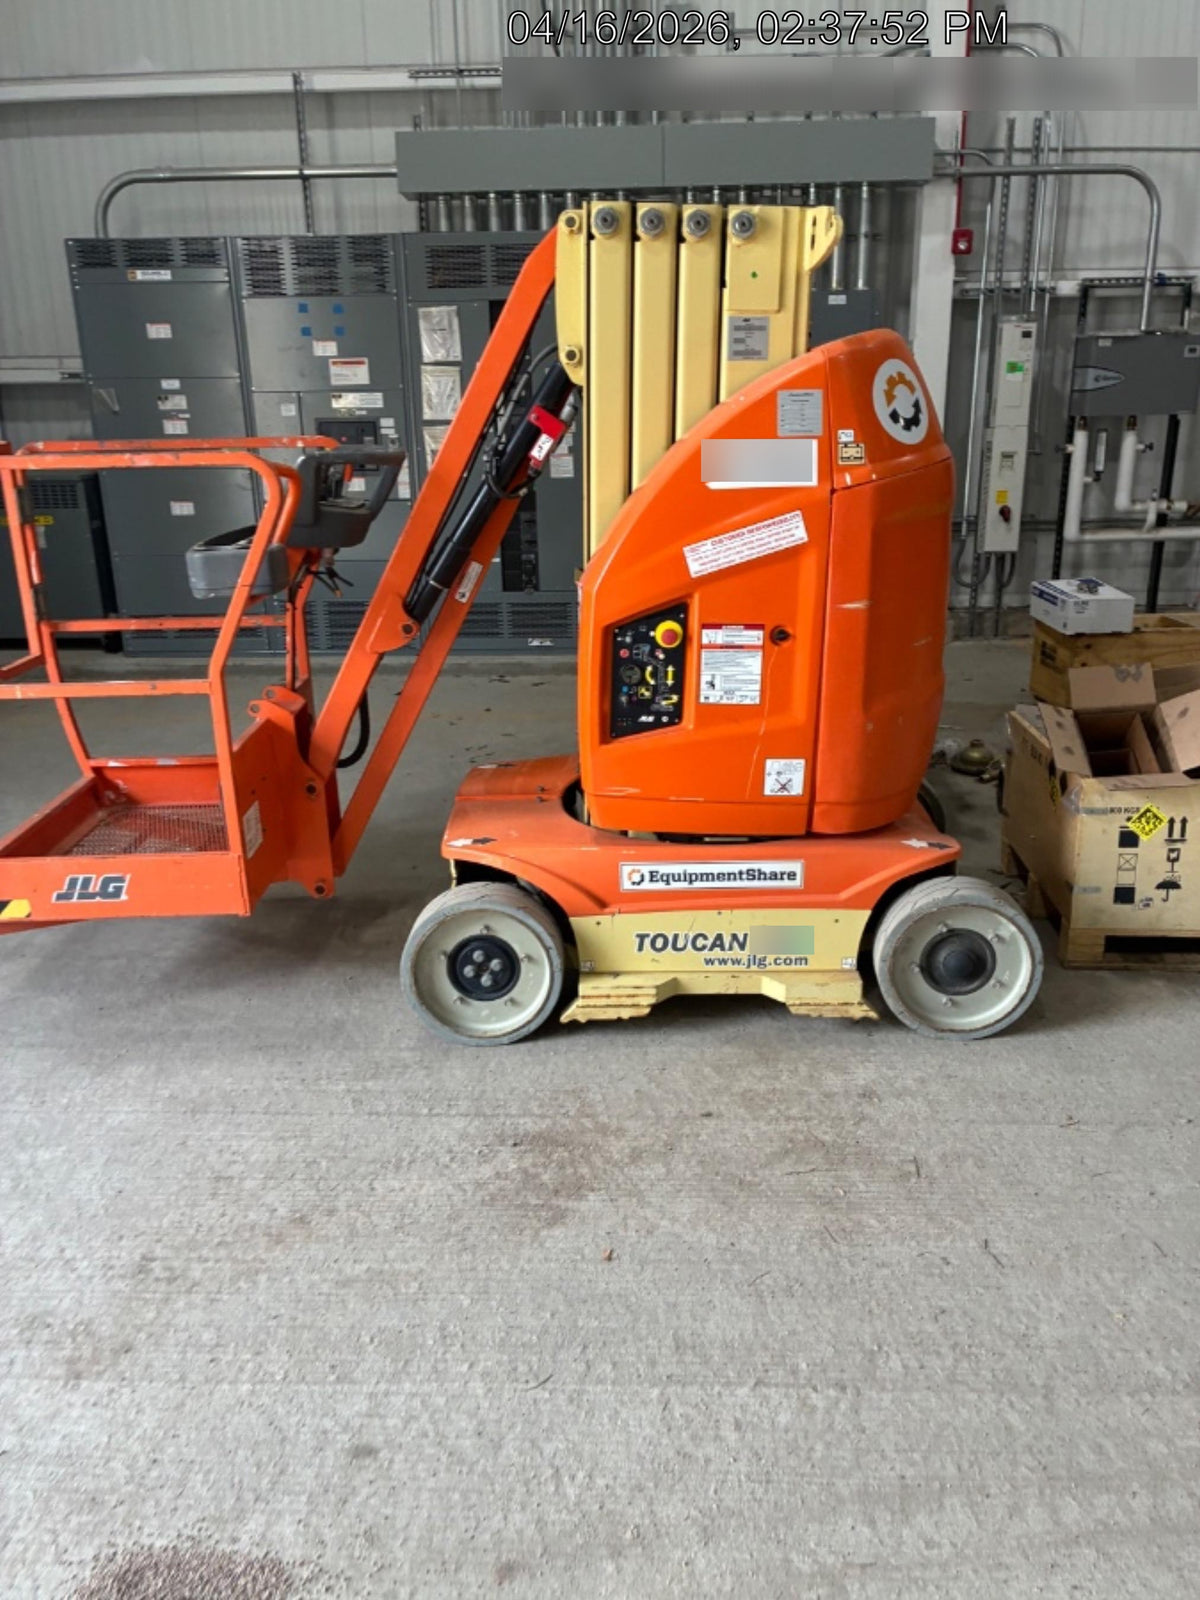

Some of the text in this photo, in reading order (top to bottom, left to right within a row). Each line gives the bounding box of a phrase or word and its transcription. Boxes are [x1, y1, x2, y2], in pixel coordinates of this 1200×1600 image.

[648, 867, 797, 886] EquipmentShare
[54, 874, 128, 902] JLG
[635, 932, 748, 953] TOUCAN
[704, 954, 809, 970] www.jlg.com
